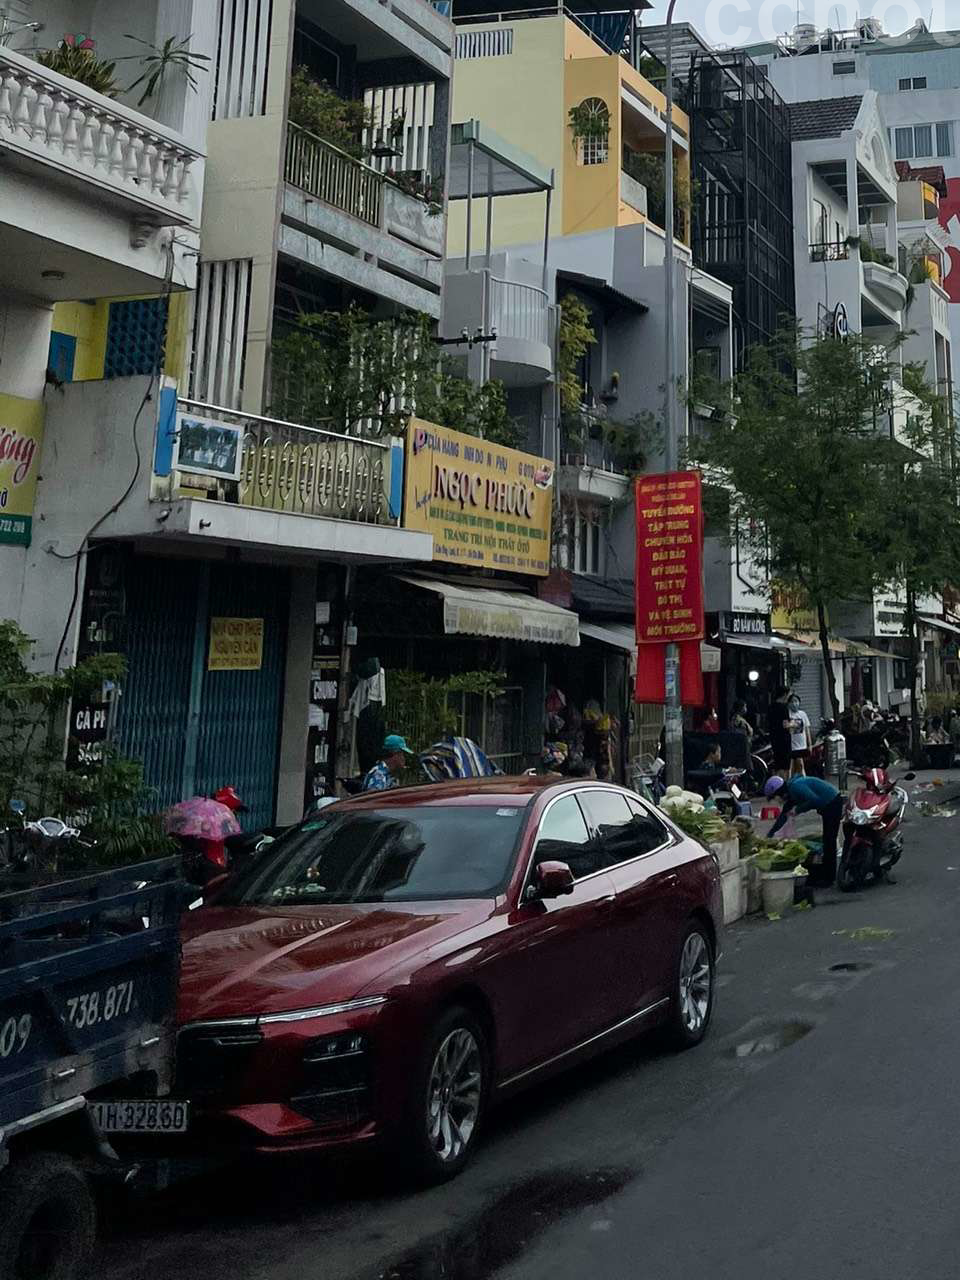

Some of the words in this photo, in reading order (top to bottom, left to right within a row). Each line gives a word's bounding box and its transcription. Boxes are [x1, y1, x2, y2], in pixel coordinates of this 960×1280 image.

[434, 465, 482, 510] NGỌC
[485, 478, 536, 519] PHƯỚC
[443, 527, 469, 546] TRANG
[66, 980, 134, 1028] 738.871
[97, 1104, 185, 1130] 1H-328.60
